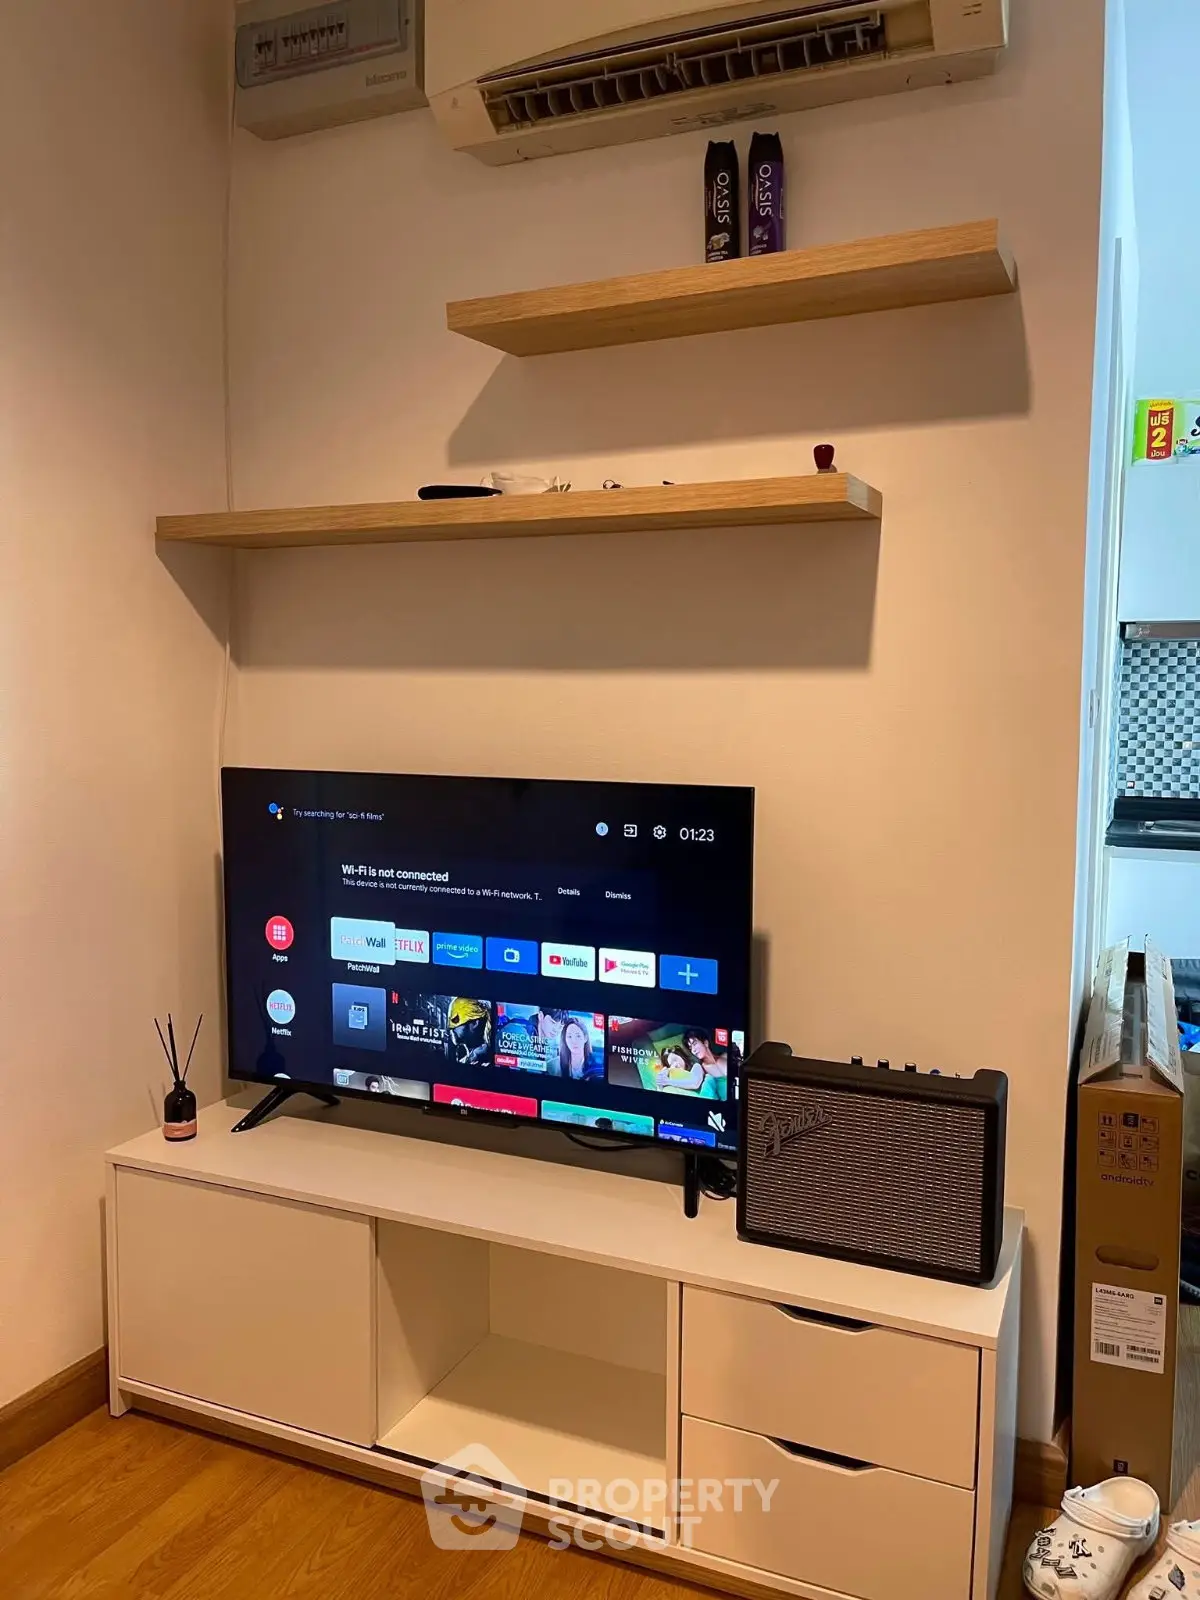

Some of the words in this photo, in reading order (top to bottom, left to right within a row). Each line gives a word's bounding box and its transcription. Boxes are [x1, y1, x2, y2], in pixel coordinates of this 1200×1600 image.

[759, 164, 772, 216] OASIS
[717, 172, 730, 224] OASIS
[1150, 412, 1170, 426] ฟรี
[1151, 427, 1167, 448] 2
[293, 808, 302, 817] Try
[304, 811, 335, 819] searching
[679, 827, 715, 842] 01:23
[341, 864, 367, 875] Wi-Fi
[368, 866, 377, 877] is
[378, 868, 395, 878] not
[396, 871, 449, 882] connected
[342, 877, 355, 886] This
[356, 880, 378, 888] device
[379, 881, 385, 889] is
[398, 883, 428, 893] currently
[429, 886, 466, 895] connected
[482, 888, 500, 897] Wi-Fi
[501, 891, 533, 900] network.
[557, 887, 581, 896] Details
[605, 890, 632, 900] Dismiss
[436, 943, 457, 951] prime
[459, 944, 479, 953] video
[272, 953, 289, 962] Apps
[562, 957, 588, 968] YouTube
[347, 962, 380, 973] PatchWall
[269, 1002, 293, 1012] NETFLIX
[271, 1027, 292, 1037] Netflix
[422, 1027, 445, 1039] FIST
[502, 1031, 549, 1046] FORECASTING
[498, 1039, 518, 1050] LOVE
[611, 1045, 659, 1058] FISHBOWL
[621, 1055, 650, 1066] WIVES
[760, 1104, 832, 1156] Fender
